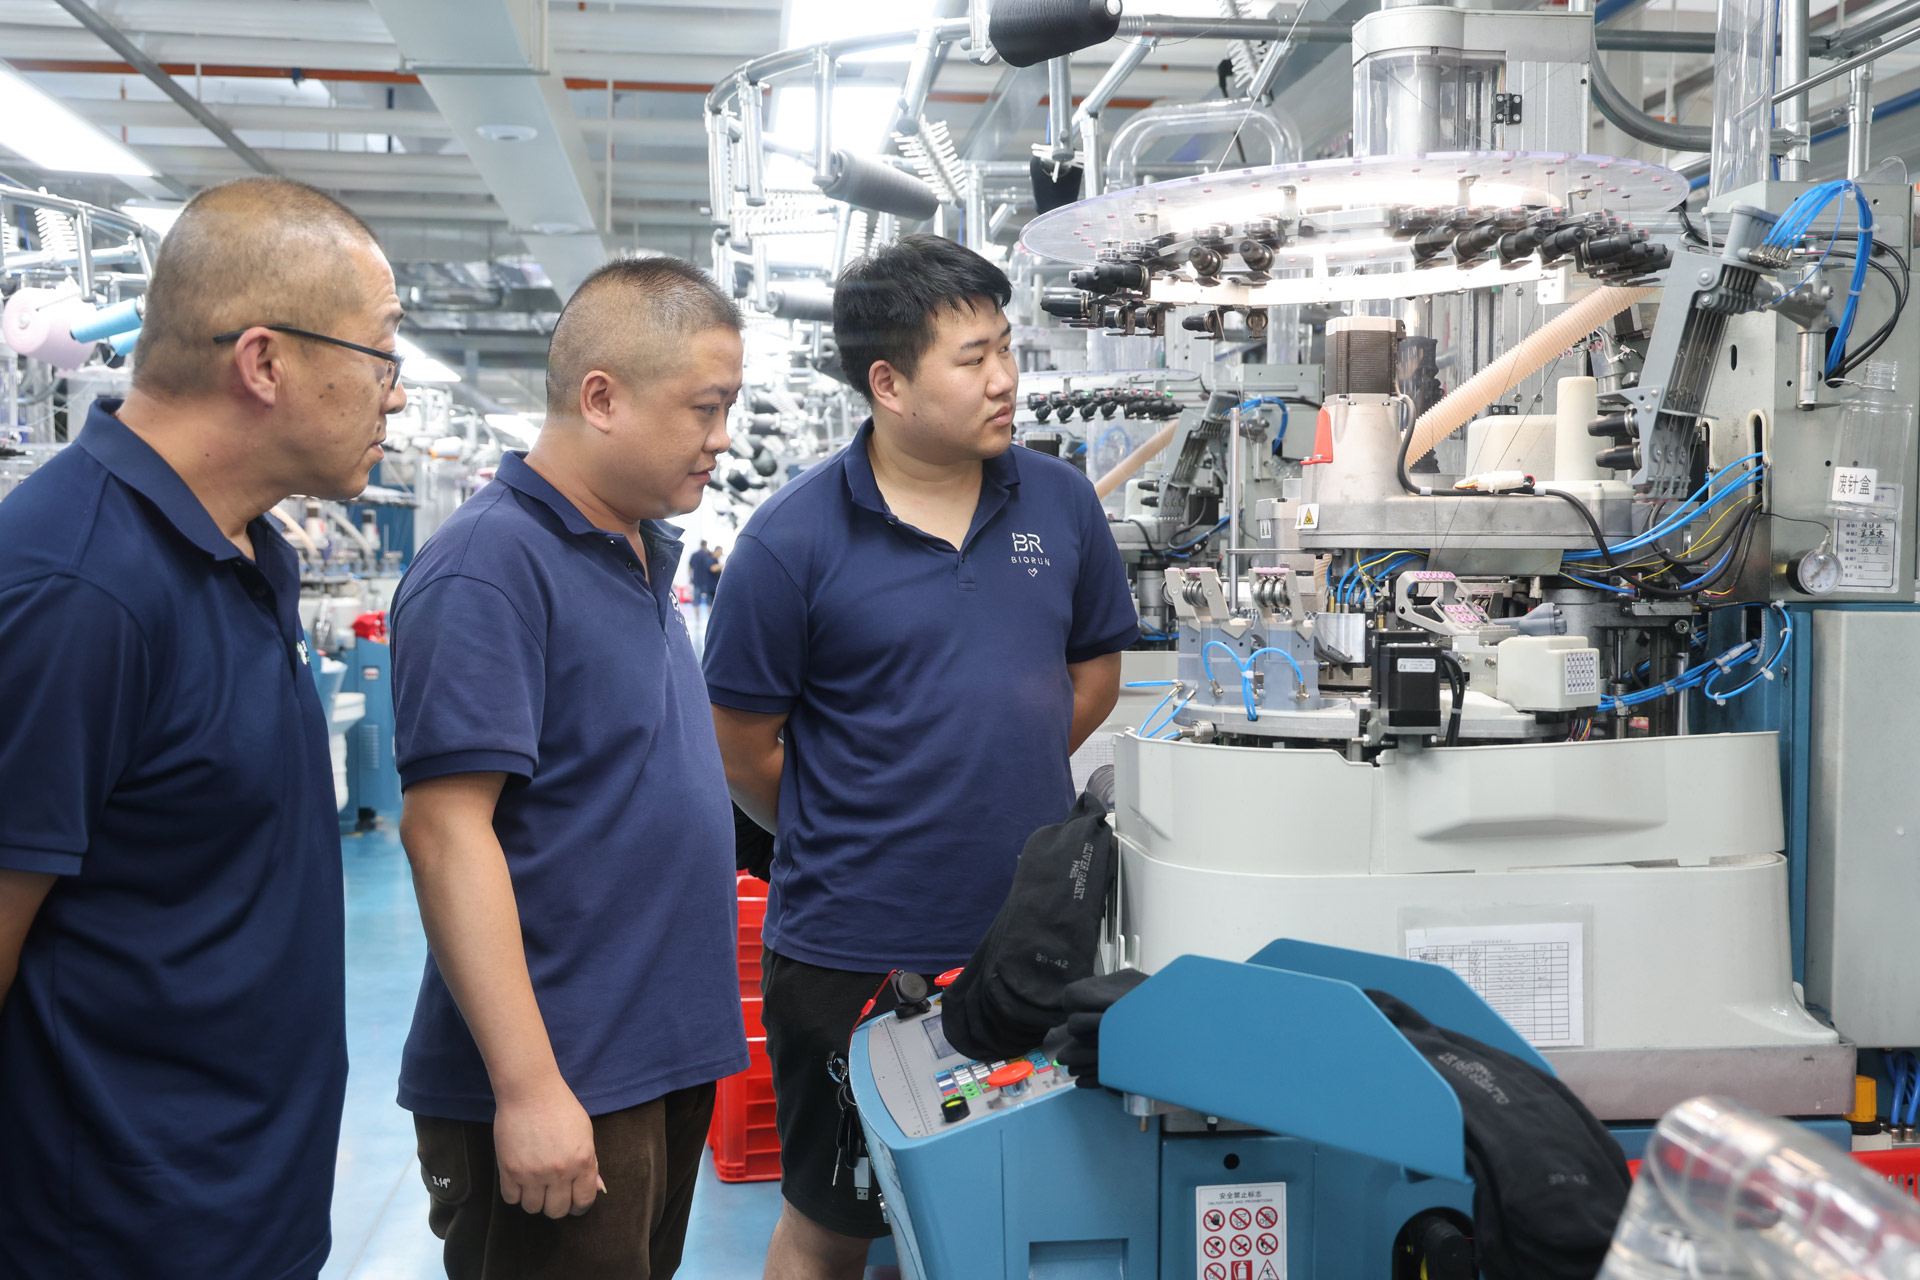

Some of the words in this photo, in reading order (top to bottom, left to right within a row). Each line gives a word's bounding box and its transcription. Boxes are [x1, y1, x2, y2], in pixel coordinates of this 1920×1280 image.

[1837, 474, 1871, 495] 废针盒
[1011, 532, 1044, 554] BR
[1010, 556, 1051, 567] BIORUN
[1079, 842, 1094, 872] OLIVER
[1073, 869, 1087, 900] GRANT
[1219, 1191, 1262, 1200] 安全禁止标志
